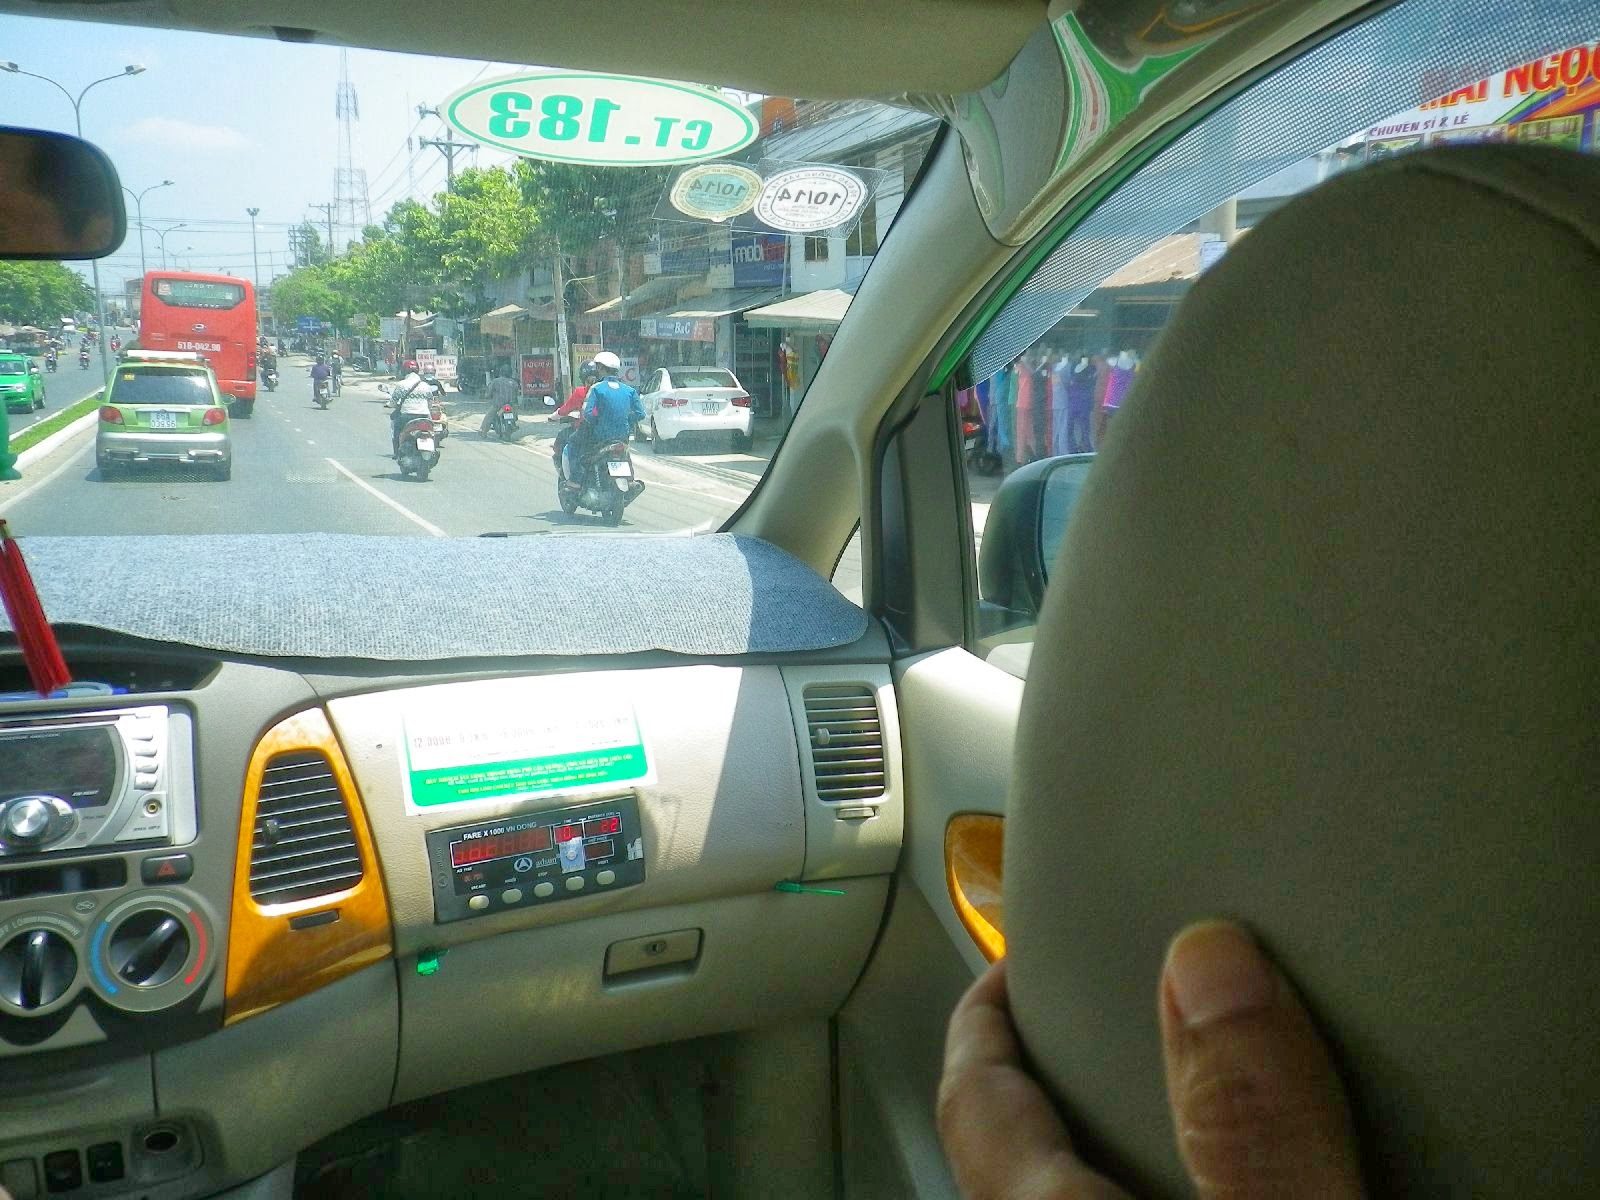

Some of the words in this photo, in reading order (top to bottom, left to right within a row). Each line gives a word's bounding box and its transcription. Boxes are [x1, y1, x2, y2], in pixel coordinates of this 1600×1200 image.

[463, 831, 482, 840] FARE
[489, 827, 505, 836] 1000
[516, 821, 537, 831] DONG
